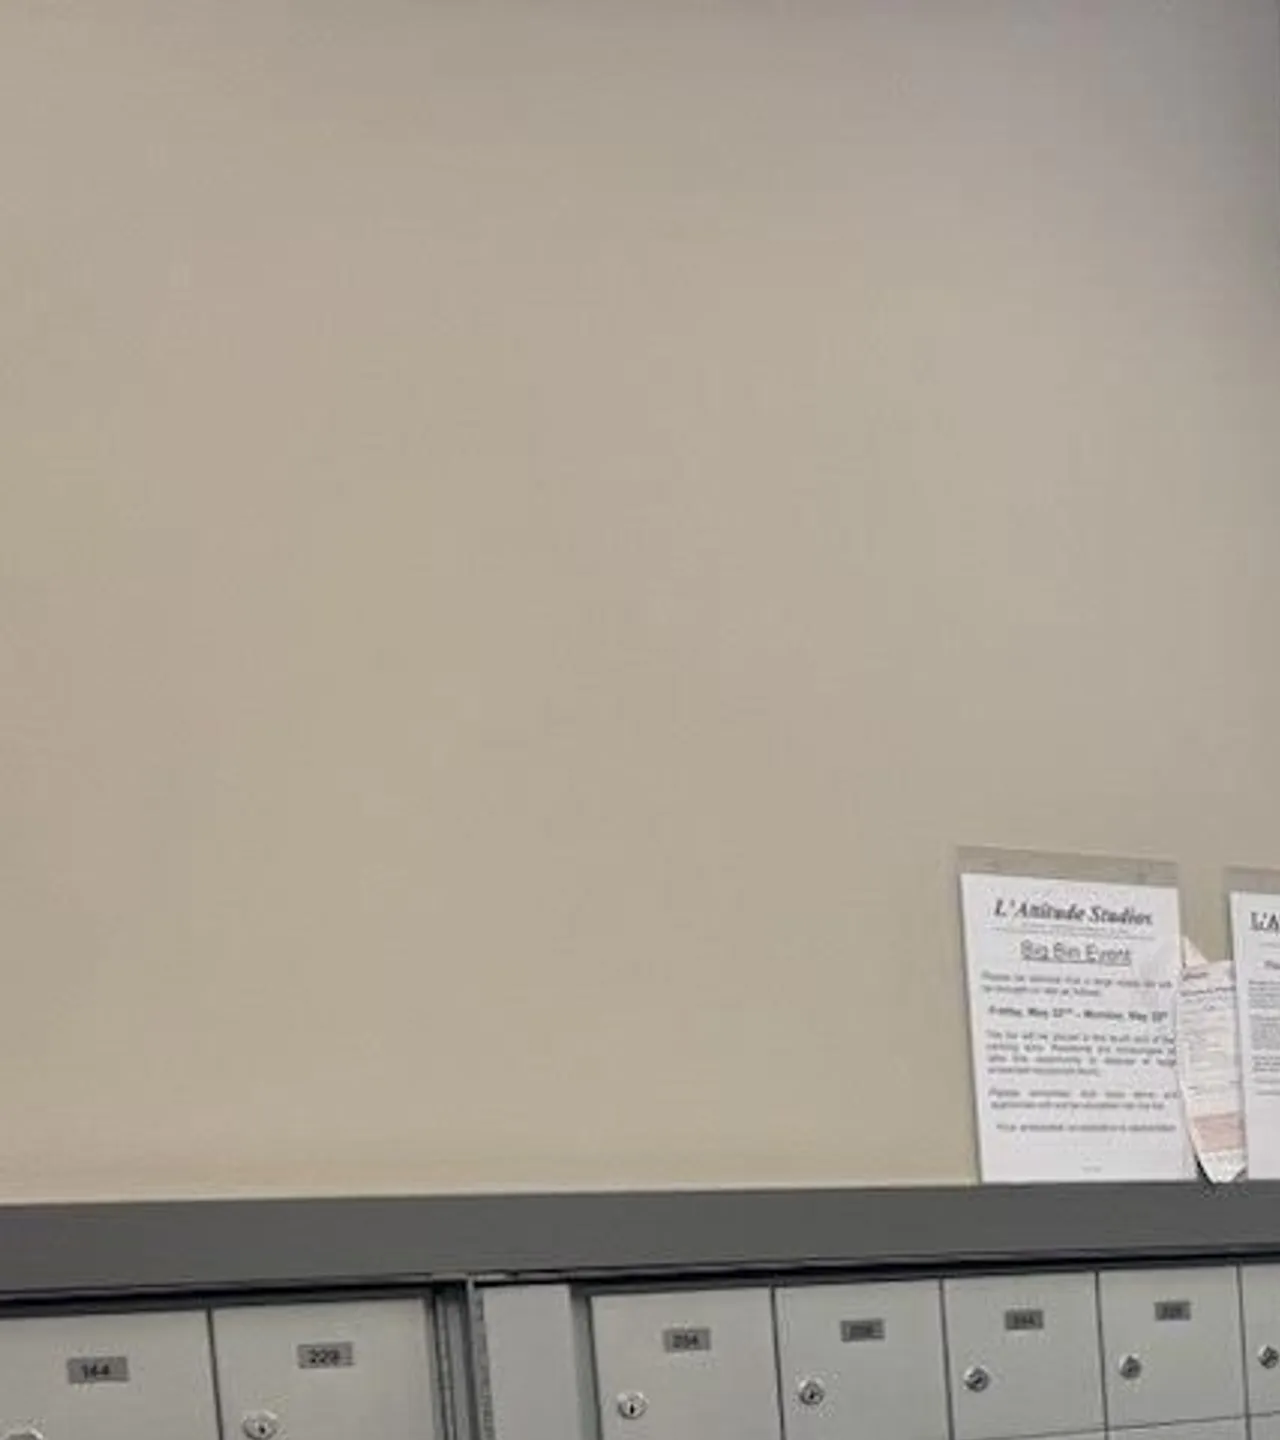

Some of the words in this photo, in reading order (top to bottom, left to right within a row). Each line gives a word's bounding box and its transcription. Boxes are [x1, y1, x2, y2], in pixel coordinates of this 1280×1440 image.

[993, 897, 1085, 921] L'Attitude
[1089, 904, 1154, 926] Studios
[1086, 943, 1132, 966] Event
[308, 1350, 341, 1366] 229
[81, 1363, 110, 1377] 144
